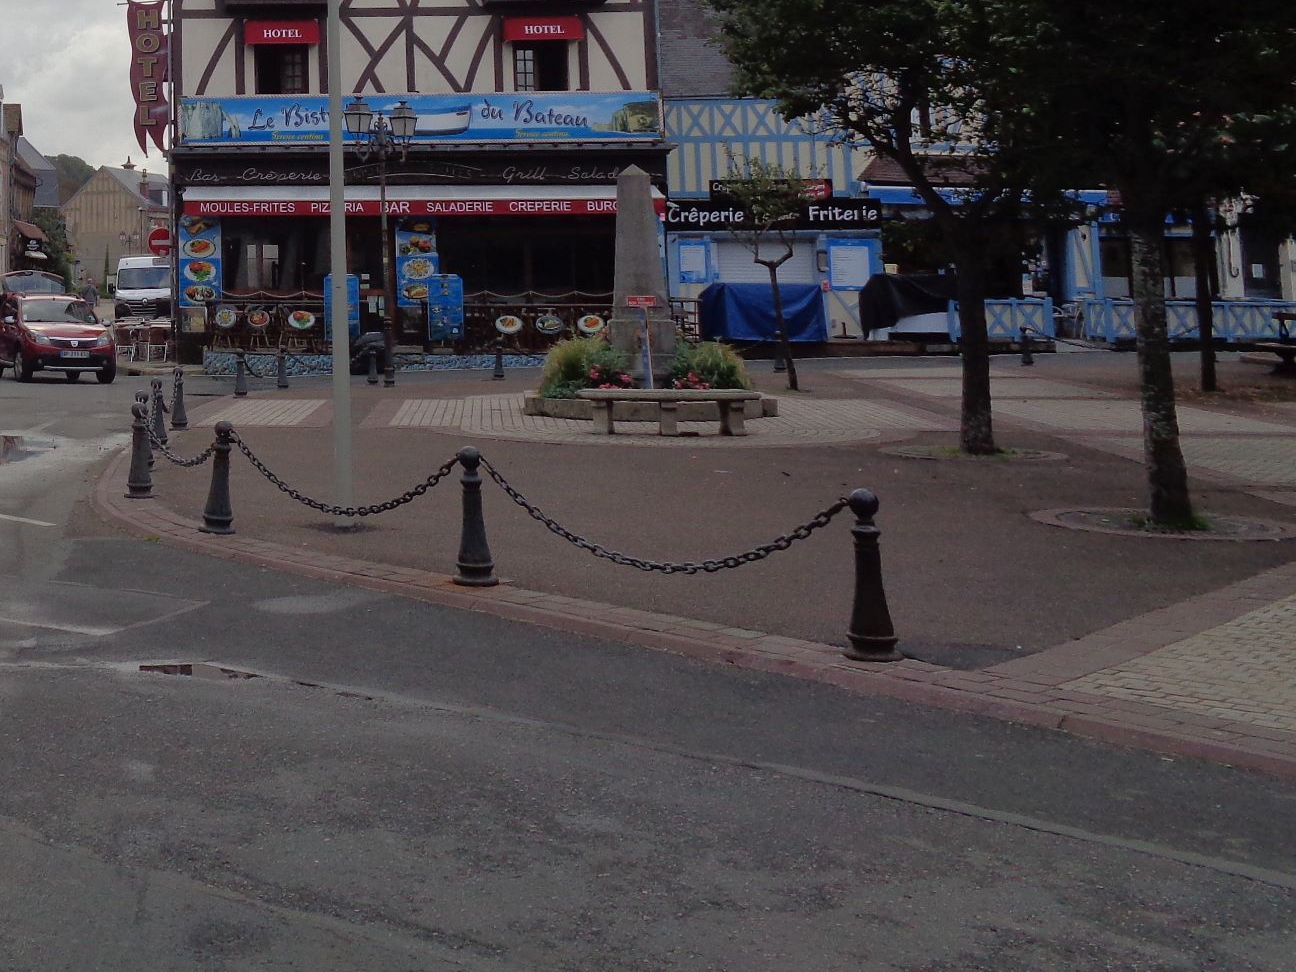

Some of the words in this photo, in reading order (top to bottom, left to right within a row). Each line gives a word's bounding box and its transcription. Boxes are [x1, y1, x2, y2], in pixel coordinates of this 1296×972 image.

[263, 28, 303, 39] HOTEL
[524, 24, 565, 35] HOTEL
[136, 9, 159, 126] HOTEL
[248, 108, 275, 131] Le
[281, 101, 330, 128] Bist
[480, 99, 504, 120] du
[512, 100, 588, 127] Bateau
[502, 166, 547, 183] Grill
[567, 166, 620, 180] Salad
[200, 202, 296, 213] MOULES-FRITES
[311, 202, 364, 212] PIZRIA
[380, 201, 410, 213] BAR
[426, 201, 494, 212] SALADERIE
[509, 201, 572, 212] CREPERIE
[668, 206, 744, 226] Crêperie
